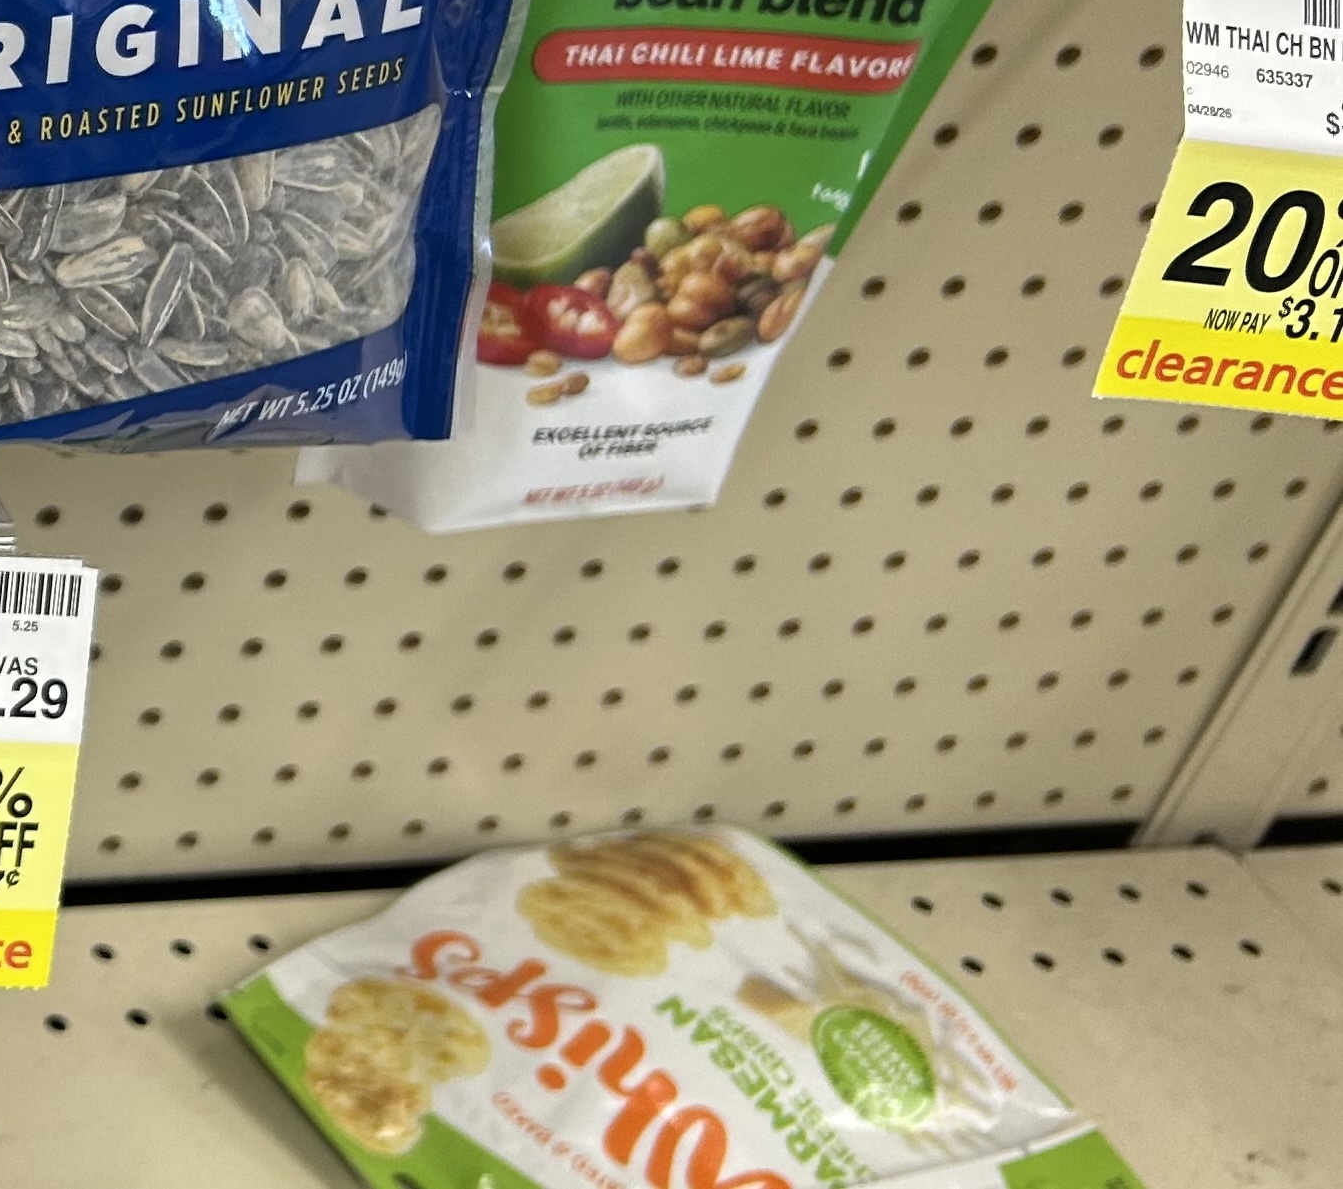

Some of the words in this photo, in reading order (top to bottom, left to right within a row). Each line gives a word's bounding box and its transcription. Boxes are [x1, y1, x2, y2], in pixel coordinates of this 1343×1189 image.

[564, 44, 625, 68] THAI
[630, 41, 706, 66] CHILI
[713, 44, 783, 71] LIME
[1186, 20, 1220, 48] WM
[1226, 25, 1270, 52] THAI
[1276, 32, 1303, 58] CH
[1186, 59, 1230, 79] 02946
[1255, 67, 1313, 88] 635337
[7, 118, 23, 146] &
[40, 102, 162, 141] ROASTED
[176, 77, 325, 124] SUNFLOWER
[336, 56, 405, 97] SEEDS
[1162, 181, 1343, 293] 20
[1203, 307, 1239, 331] NOW
[1240, 311, 1271, 335] PAY
[1116, 339, 1343, 400] clearance
[531, 424, 642, 446] EXCELLENT
